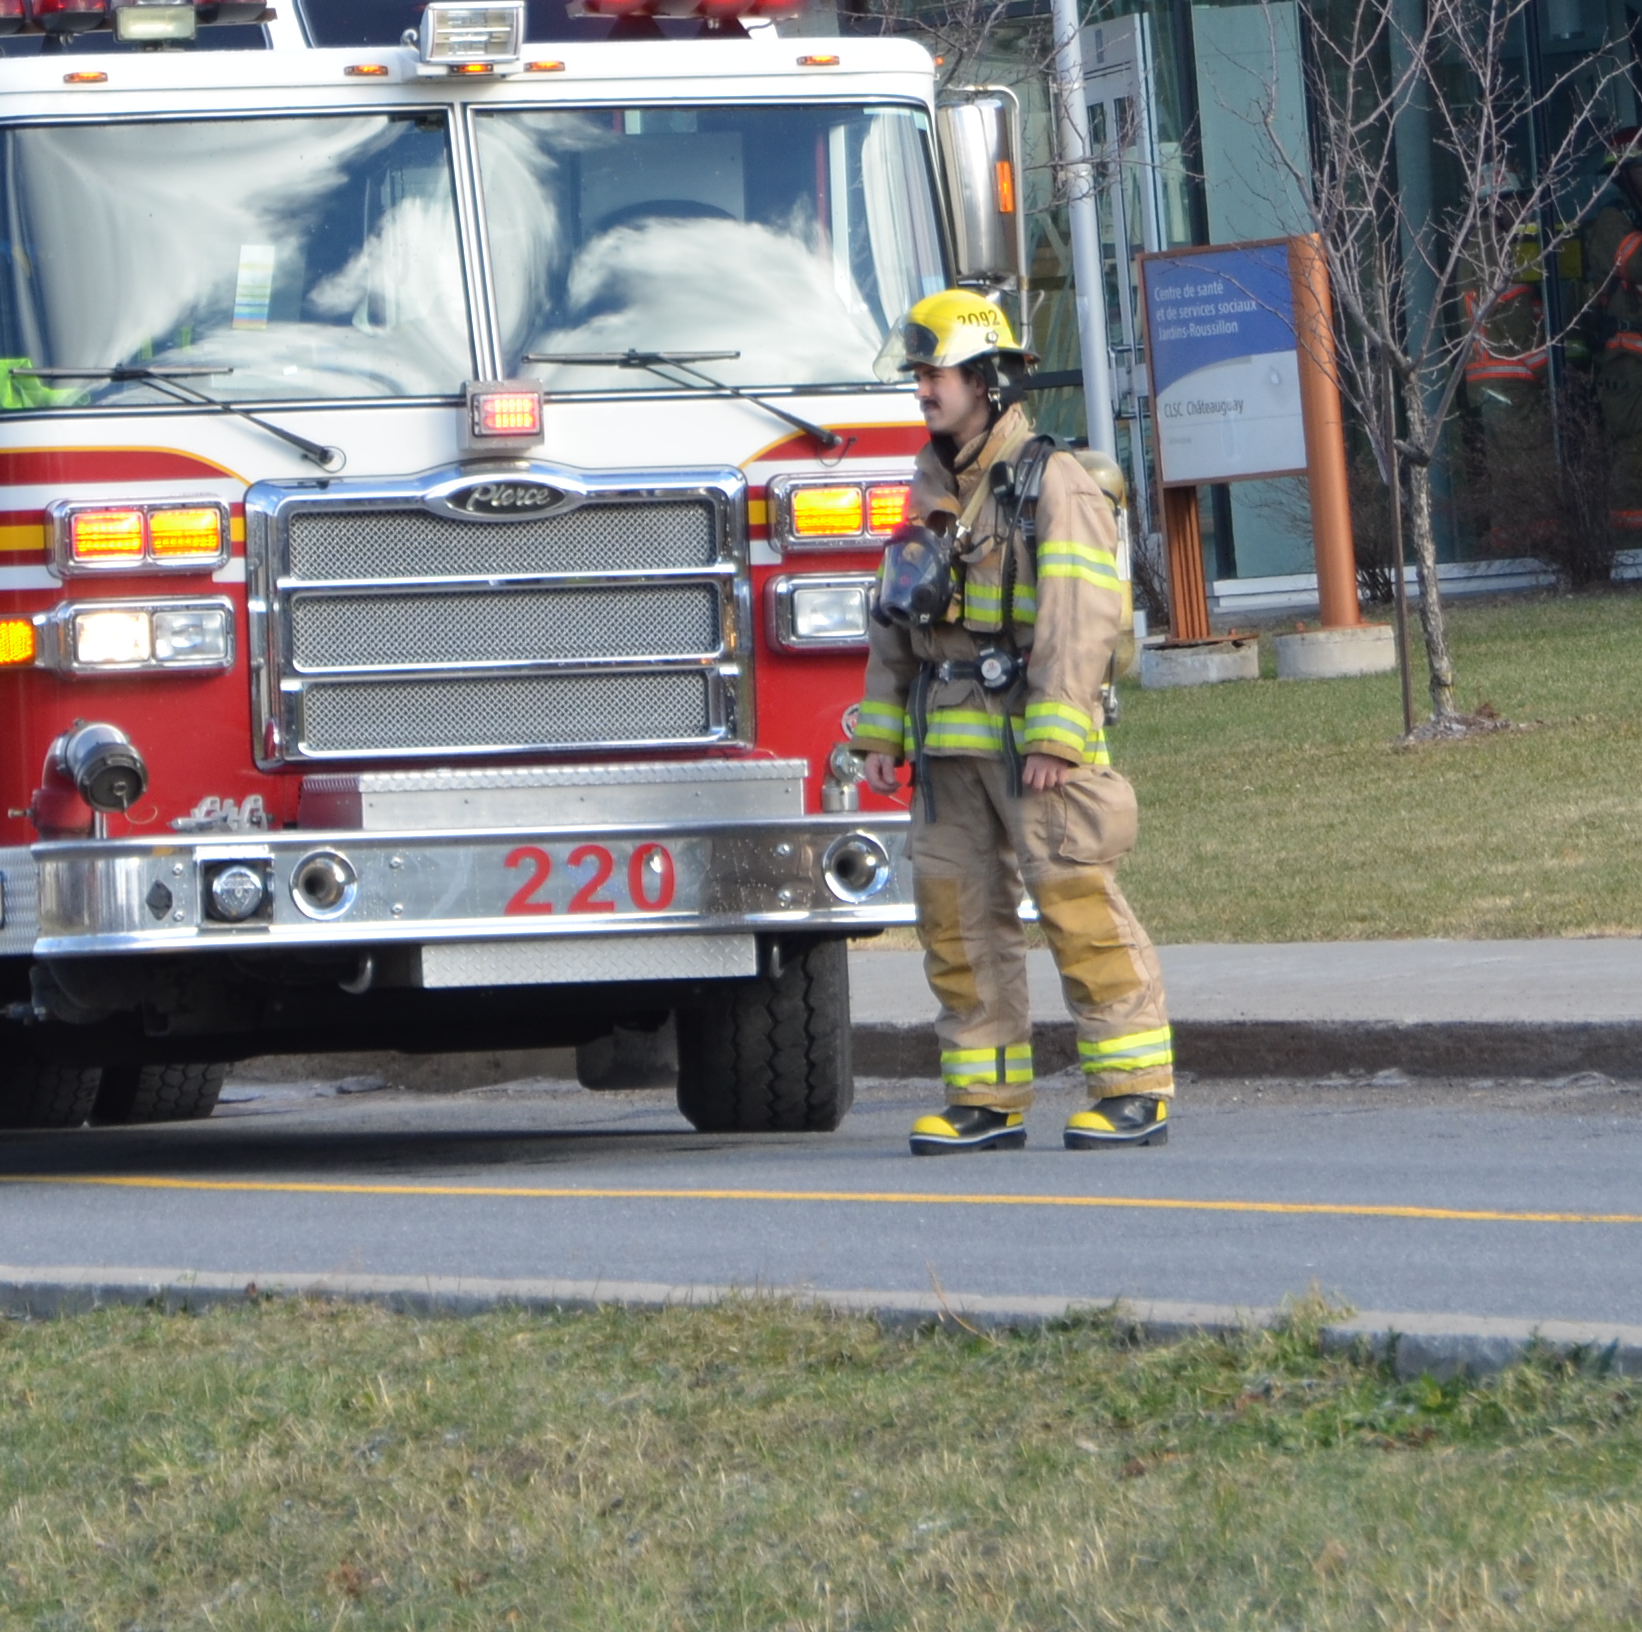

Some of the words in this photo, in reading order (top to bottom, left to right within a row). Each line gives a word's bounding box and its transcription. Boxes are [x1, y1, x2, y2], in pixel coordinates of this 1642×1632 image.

[1154, 287, 1182, 302] Centre
[1183, 284, 1195, 298] de
[1197, 279, 1224, 297] santé
[1156, 308, 1165, 322] et
[1166, 306, 1177, 320] de
[1178, 303, 1216, 319] services
[1218, 298, 1258, 315] sociaux
[1158, 320, 1239, 342] Jardins-Roussillon
[1164, 402, 1184, 418] CLSC
[1186, 399, 1244, 417] Châteauguay
[466, 483, 551, 512] Pierce
[503, 842, 676, 915] 220
